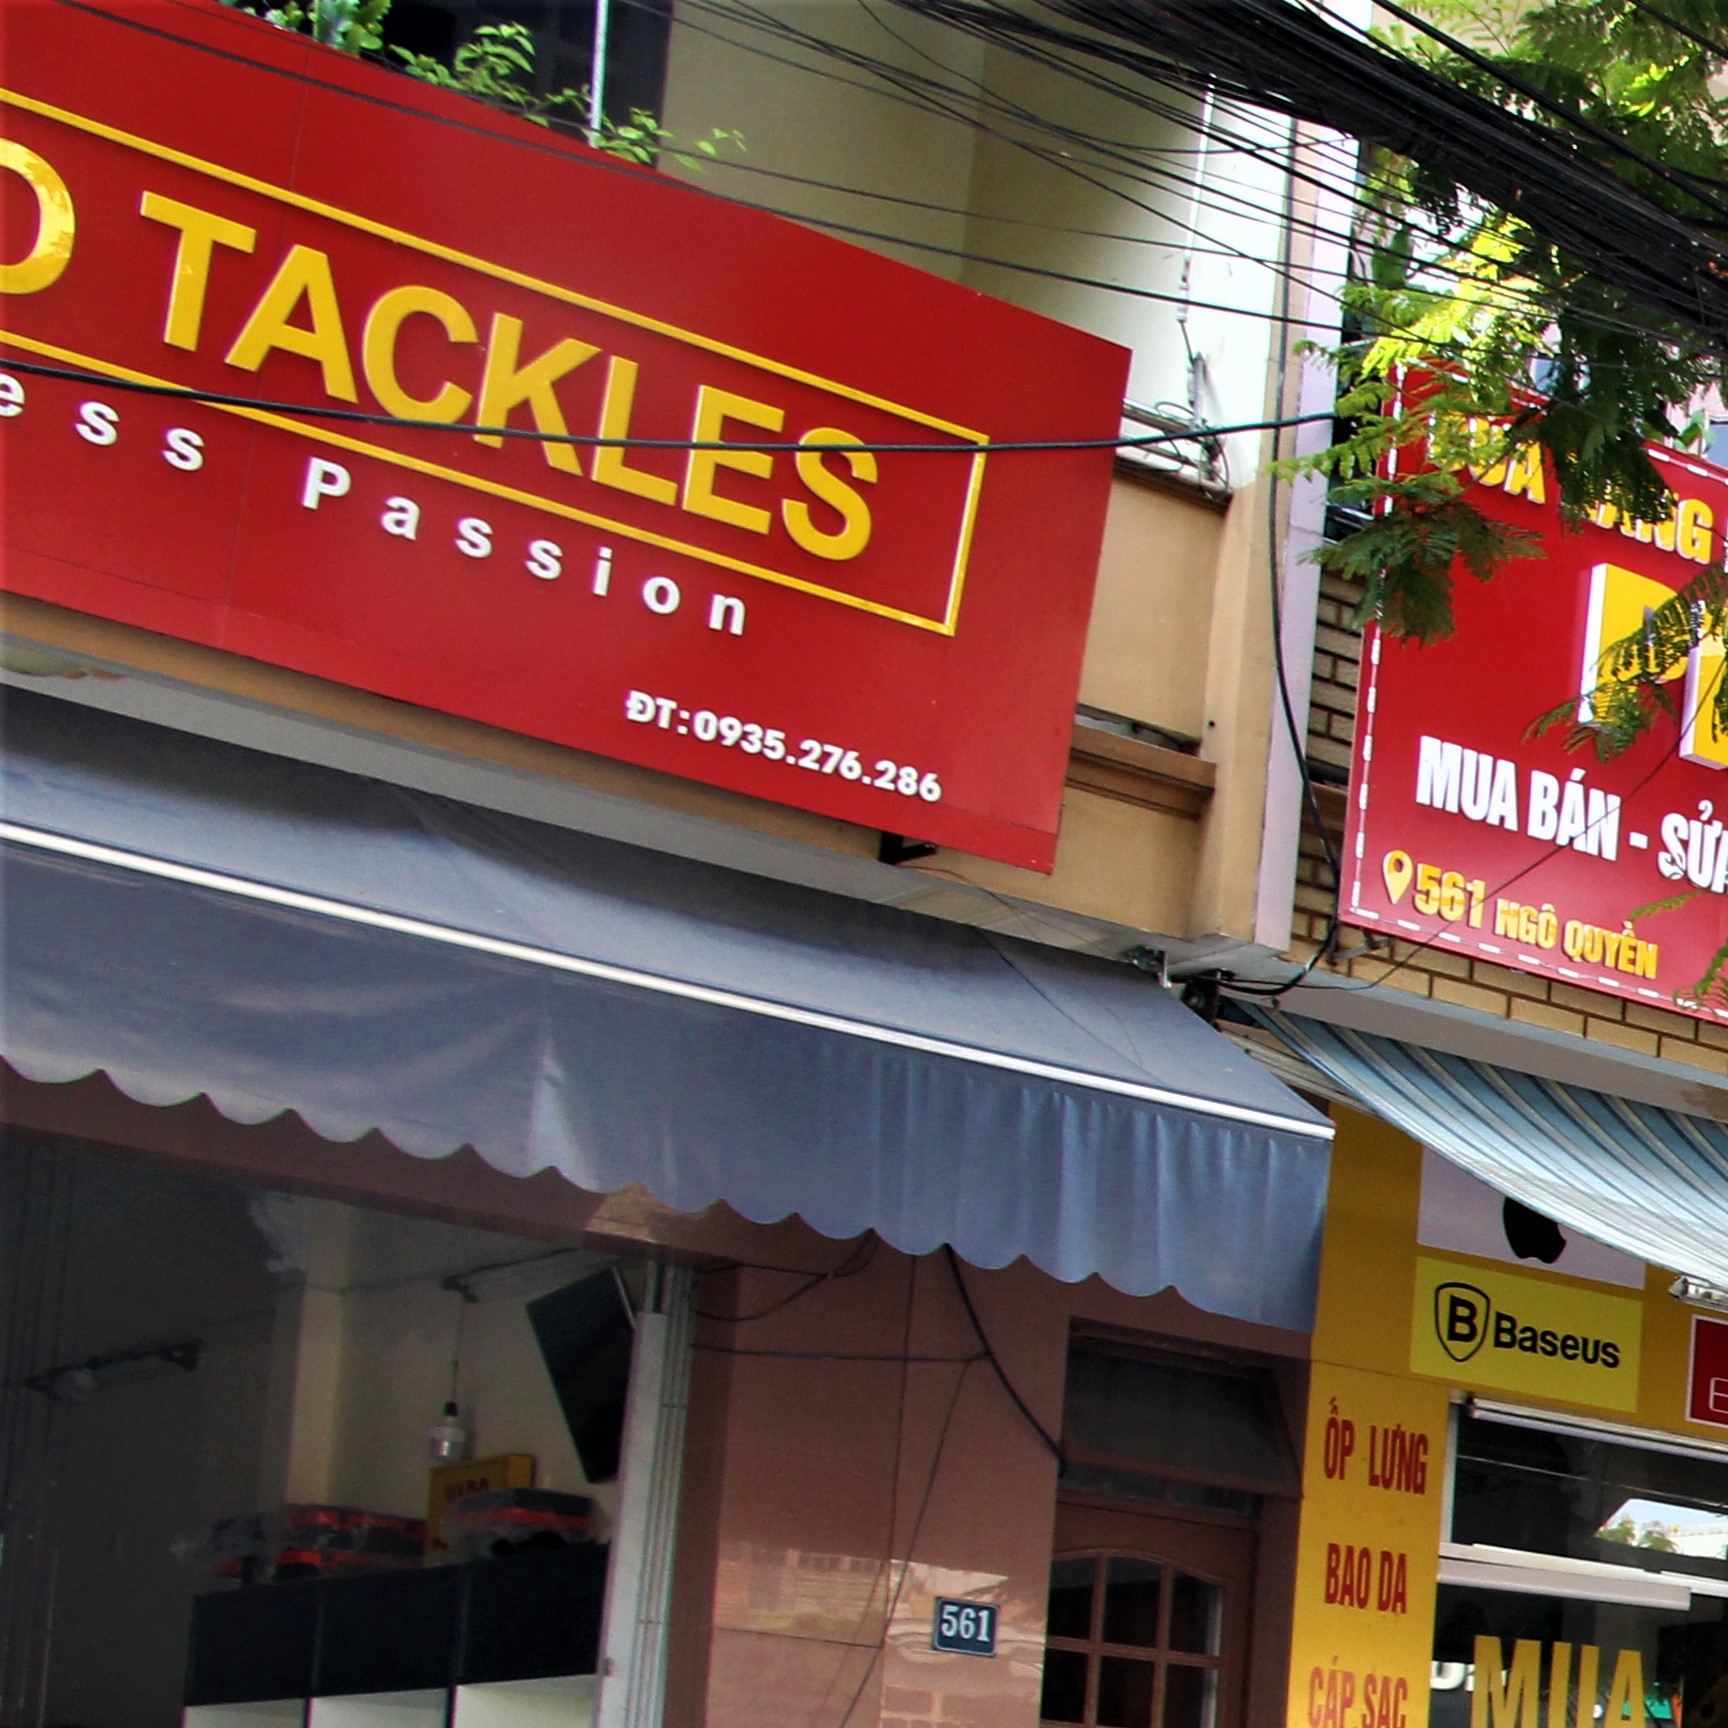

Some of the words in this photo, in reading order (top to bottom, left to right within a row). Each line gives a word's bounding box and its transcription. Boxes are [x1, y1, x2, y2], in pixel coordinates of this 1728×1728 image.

[140, 190, 879, 561] TACKLES
[301, 455, 746, 636] Passion
[623, 690, 943, 803] ĐT:0935.276.286
[1416, 735, 1518, 832] MUA
[1527, 767, 1621, 861] BÁN
[1413, 863, 1487, 929] 561
[1495, 896, 1558, 948] NGÔ
[1564, 904, 1658, 980] QUYỀN
[1492, 1309, 1620, 1370] Baseus
[1323, 1397, 1355, 1481] ỐP
[1368, 1423, 1429, 1495] LƯNG
[941, 1605, 990, 1641] 561
[1324, 1542, 1371, 1610] BAO
[1377, 1550, 1408, 1615] DA
